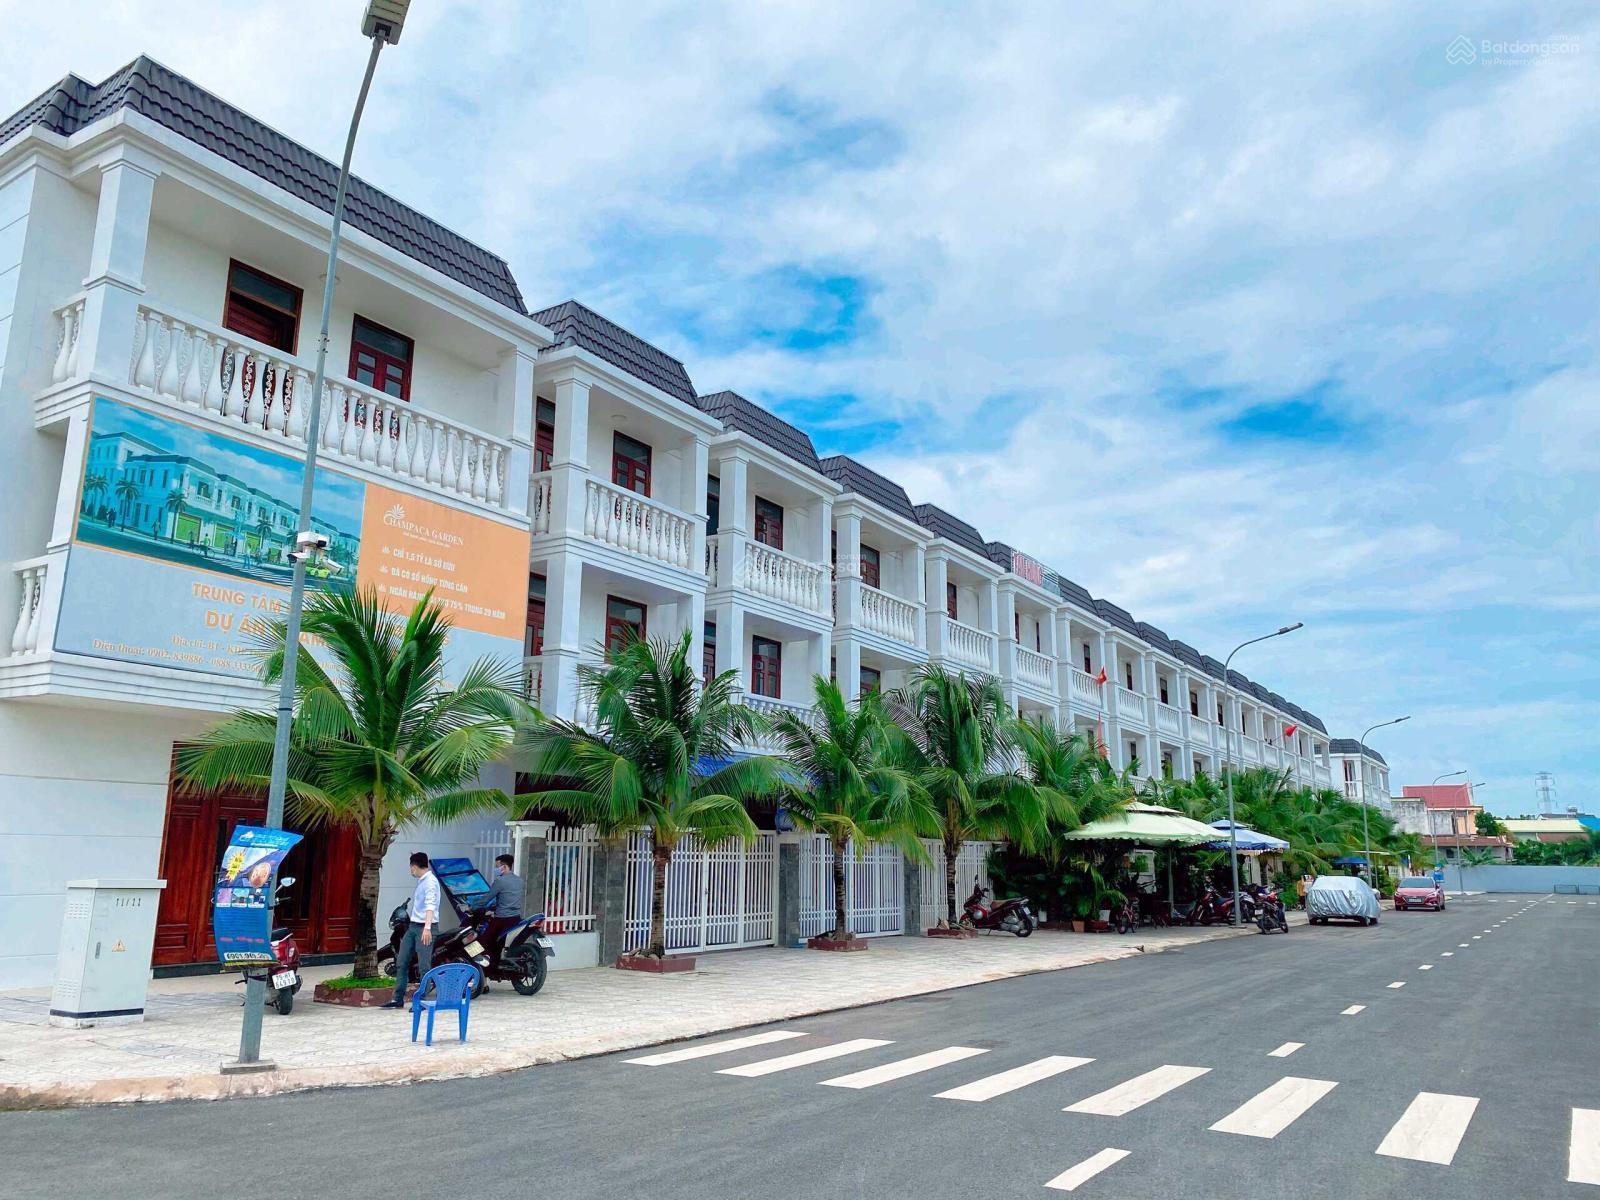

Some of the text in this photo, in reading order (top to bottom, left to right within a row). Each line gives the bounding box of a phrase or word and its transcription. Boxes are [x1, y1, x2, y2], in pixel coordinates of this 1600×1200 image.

[384, 511, 431, 537] CHAMPACA
[431, 529, 465, 546] GARDEN
[193, 583, 246, 606] TRUNG
[251, 593, 281, 613] TÂM
[206, 610, 235, 635] DỰ
